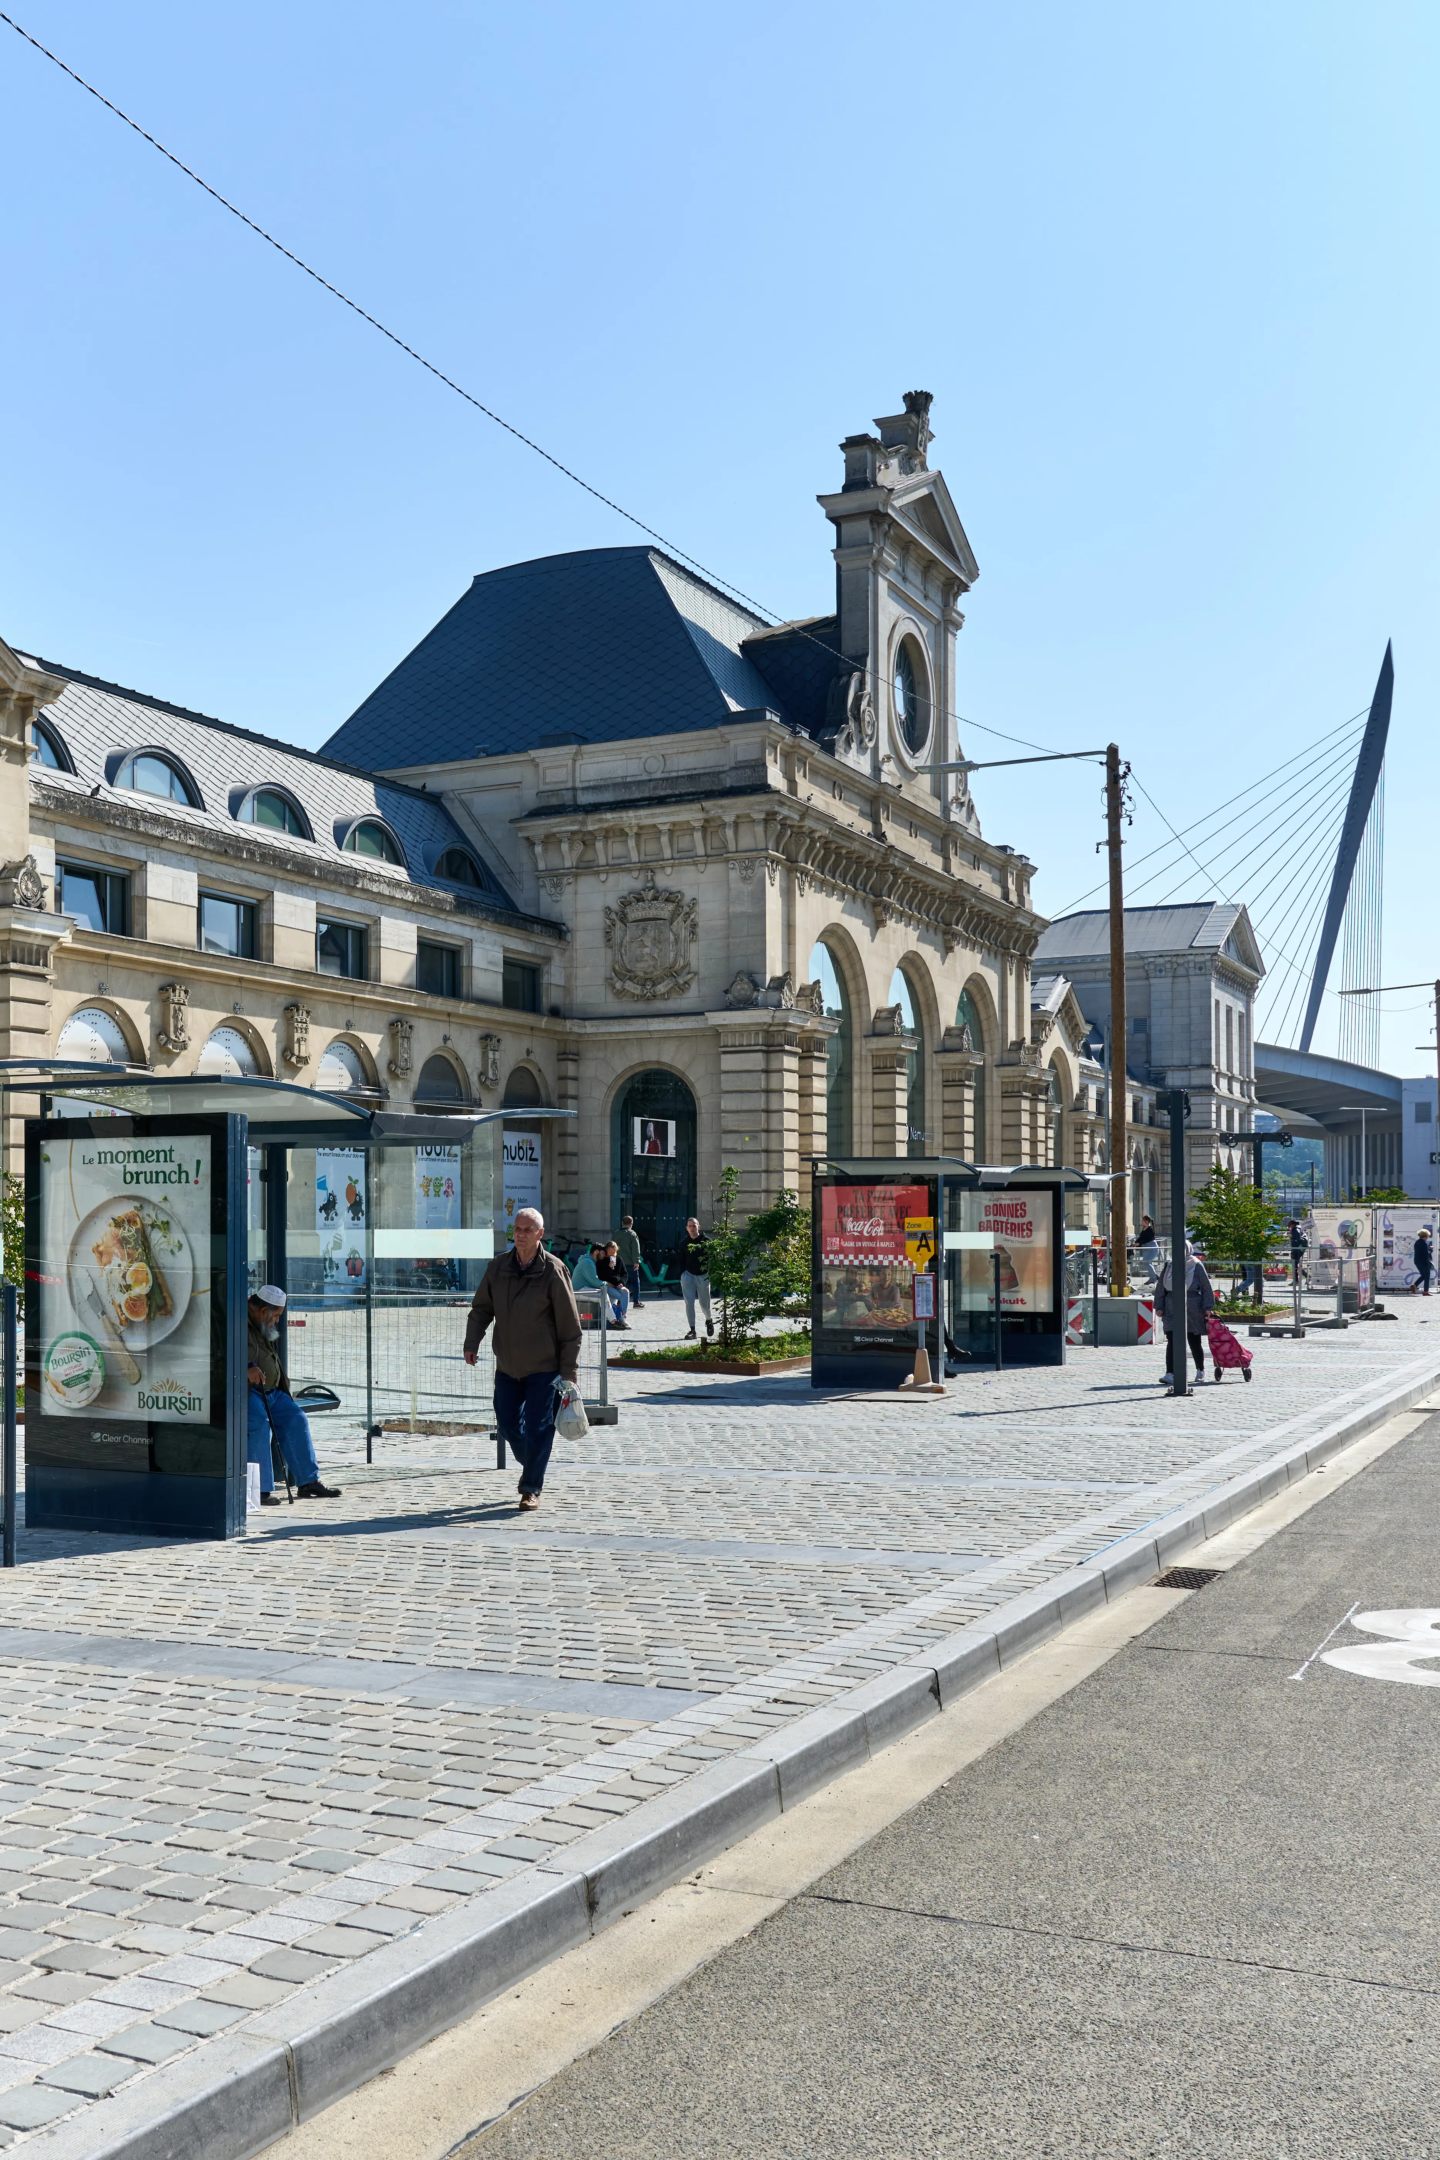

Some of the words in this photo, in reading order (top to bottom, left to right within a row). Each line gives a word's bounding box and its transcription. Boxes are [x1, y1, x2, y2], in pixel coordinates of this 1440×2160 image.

[82, 1155, 94, 1164] Le
[97, 1145, 175, 1164] moment
[503, 1140, 538, 1161] hubiz
[853, 1190, 866, 1203] TA
[867, 1189, 894, 1203] PIZZA
[889, 1205, 911, 1219] AVEC
[984, 1201, 1027, 1218] BONNES
[978, 1217, 1033, 1239] BACTÉRIES
[916, 1232, 931, 1252] A
[988, 1297, 1027, 1305] Ykult
[101, 1433, 122, 1443] Clear
[122, 1434, 154, 1445] Channel
